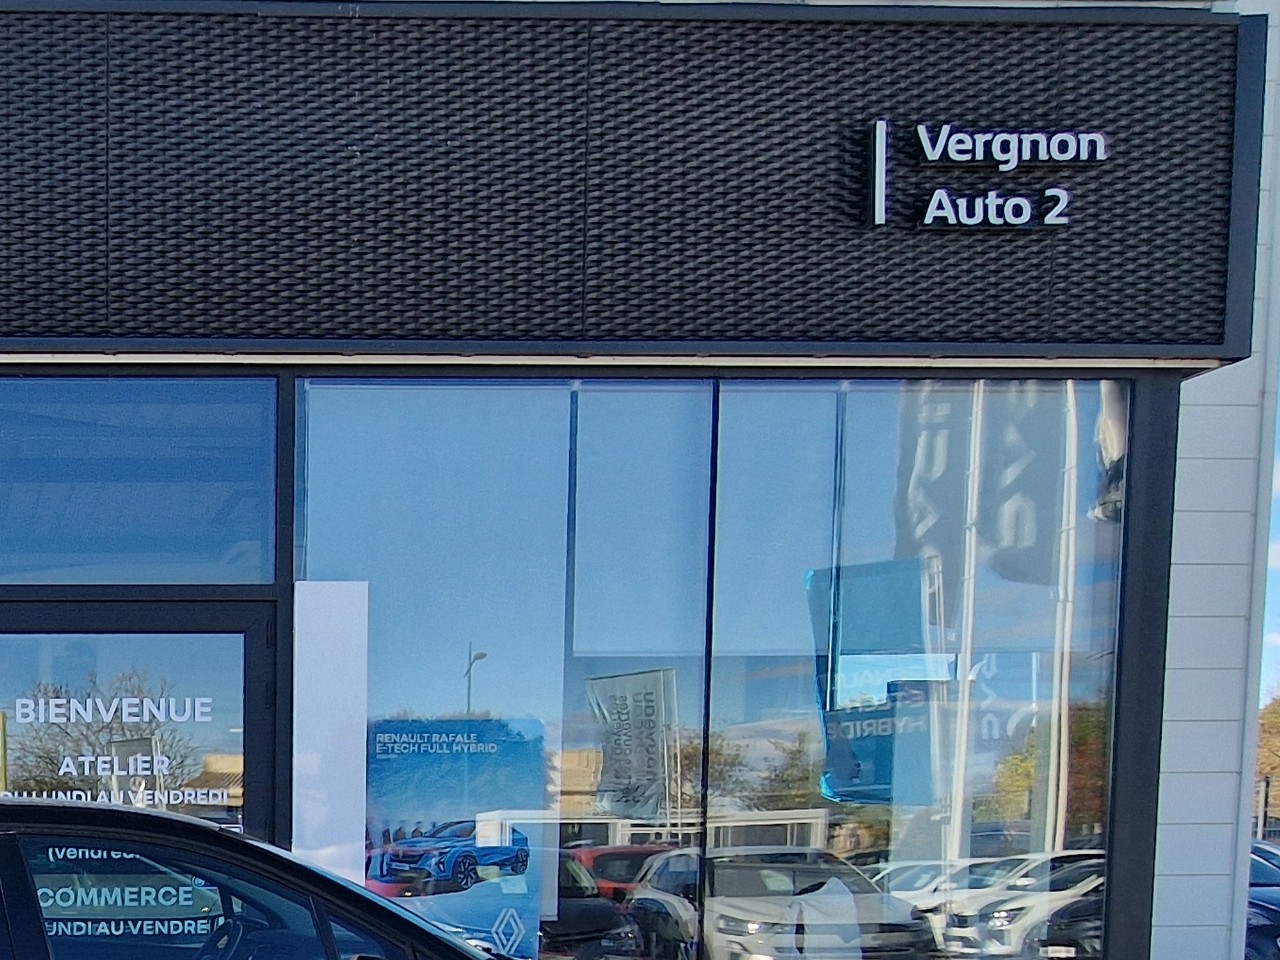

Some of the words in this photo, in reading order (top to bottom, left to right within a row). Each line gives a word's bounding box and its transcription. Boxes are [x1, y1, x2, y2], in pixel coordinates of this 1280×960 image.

[917, 124, 1108, 172] Vergnon
[923, 188, 1032, 225] Auto
[1042, 188, 1070, 225] 2
[15, 697, 213, 724] BIENVENUE
[376, 733, 431, 743] RENAULT
[432, 733, 477, 743] RAFALE
[376, 743, 418, 753] E-TECH
[421, 743, 450, 753] FULL
[453, 743, 497, 753] HYBRID
[58, 755, 171, 776] ATELIER
[128, 788, 228, 806] VENDREDI
[37, 886, 193, 907] COMMERCE
[45, 921, 92, 935] UNDI
[96, 921, 124, 936] AU
[128, 919, 212, 935] VENDRE
